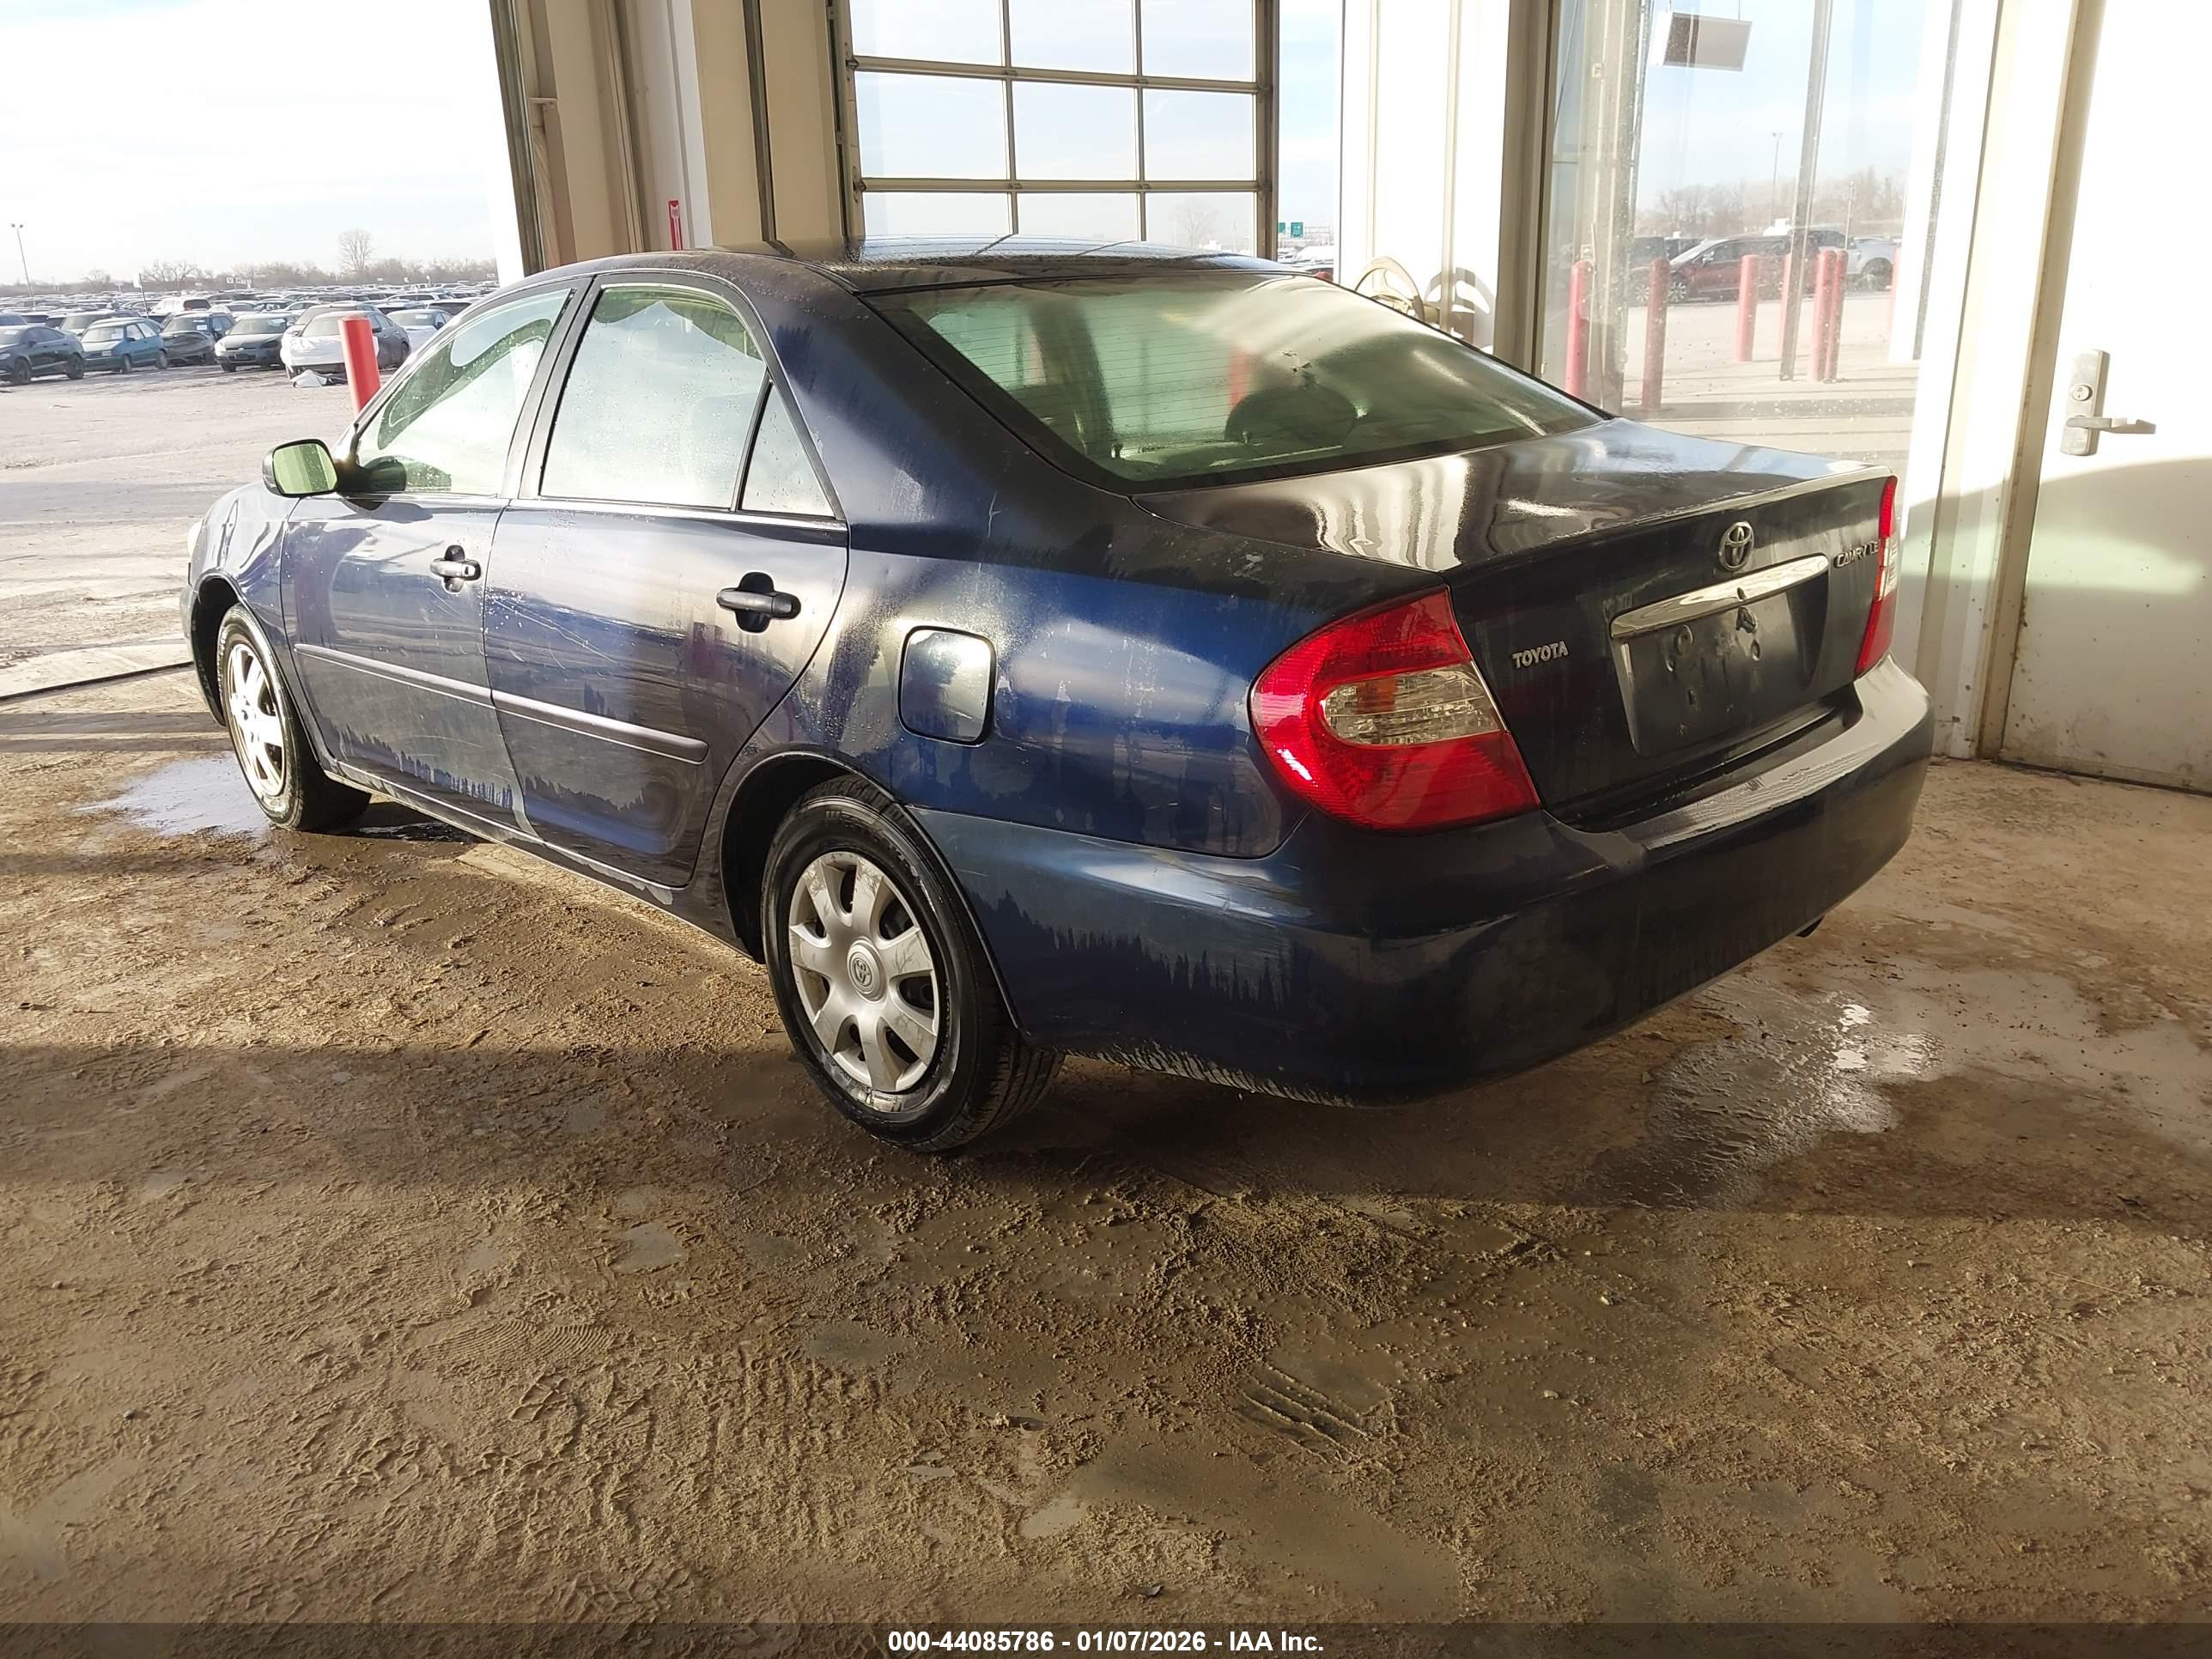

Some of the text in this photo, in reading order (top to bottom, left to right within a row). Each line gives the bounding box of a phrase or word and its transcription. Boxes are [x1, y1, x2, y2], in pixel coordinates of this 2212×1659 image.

[1835, 540, 1879, 568] CAMRY LE
[1511, 641, 1569, 669] TOYOTA
